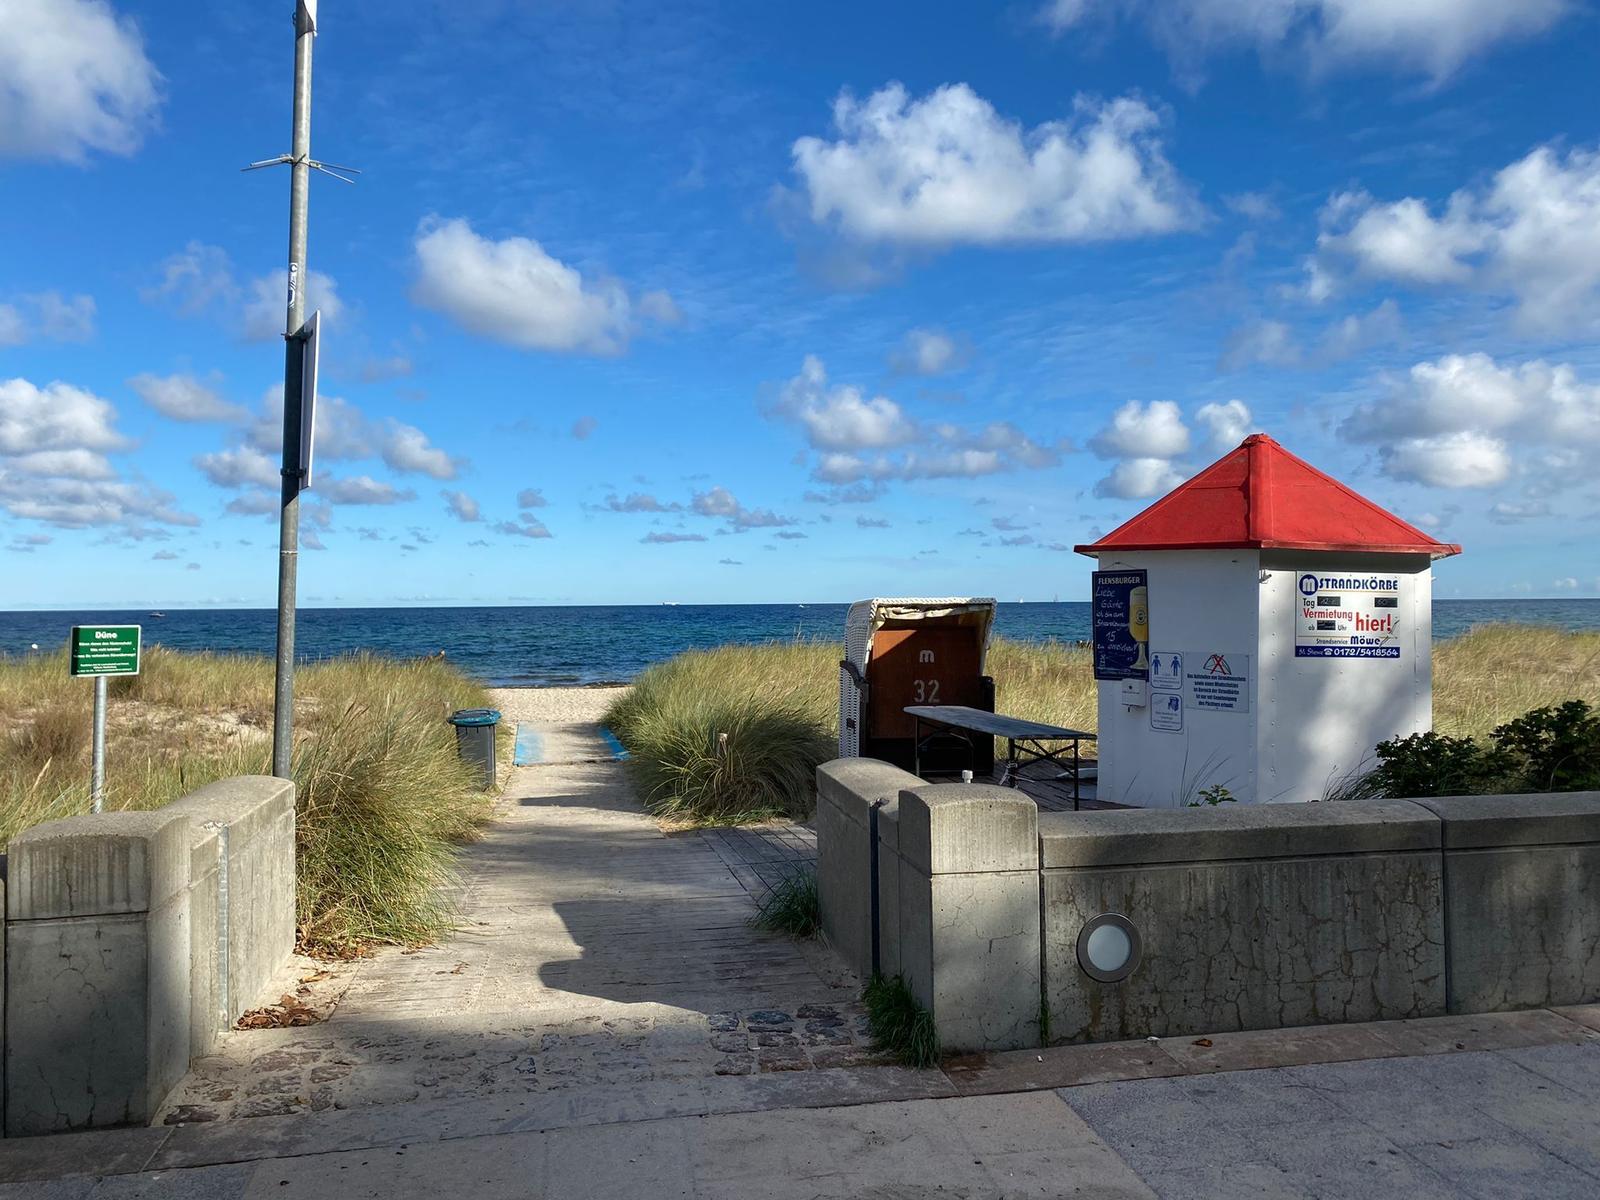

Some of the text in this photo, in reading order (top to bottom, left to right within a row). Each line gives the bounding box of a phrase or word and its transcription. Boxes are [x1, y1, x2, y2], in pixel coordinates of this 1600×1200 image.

[1098, 576, 1141, 585] FLENSBURGER
[1319, 577, 1398, 590] STRANDKÖRBE
[1303, 598, 1316, 609] Tag
[1303, 608, 1353, 622] Vermietung
[1356, 612, 1391, 631] hier!
[1106, 631, 1116, 641] 15
[1350, 636, 1381, 645] Möwe
[919, 649, 935, 663] m
[1334, 648, 1398, 656] 0172/5418564
[913, 680, 941, 703] 32
